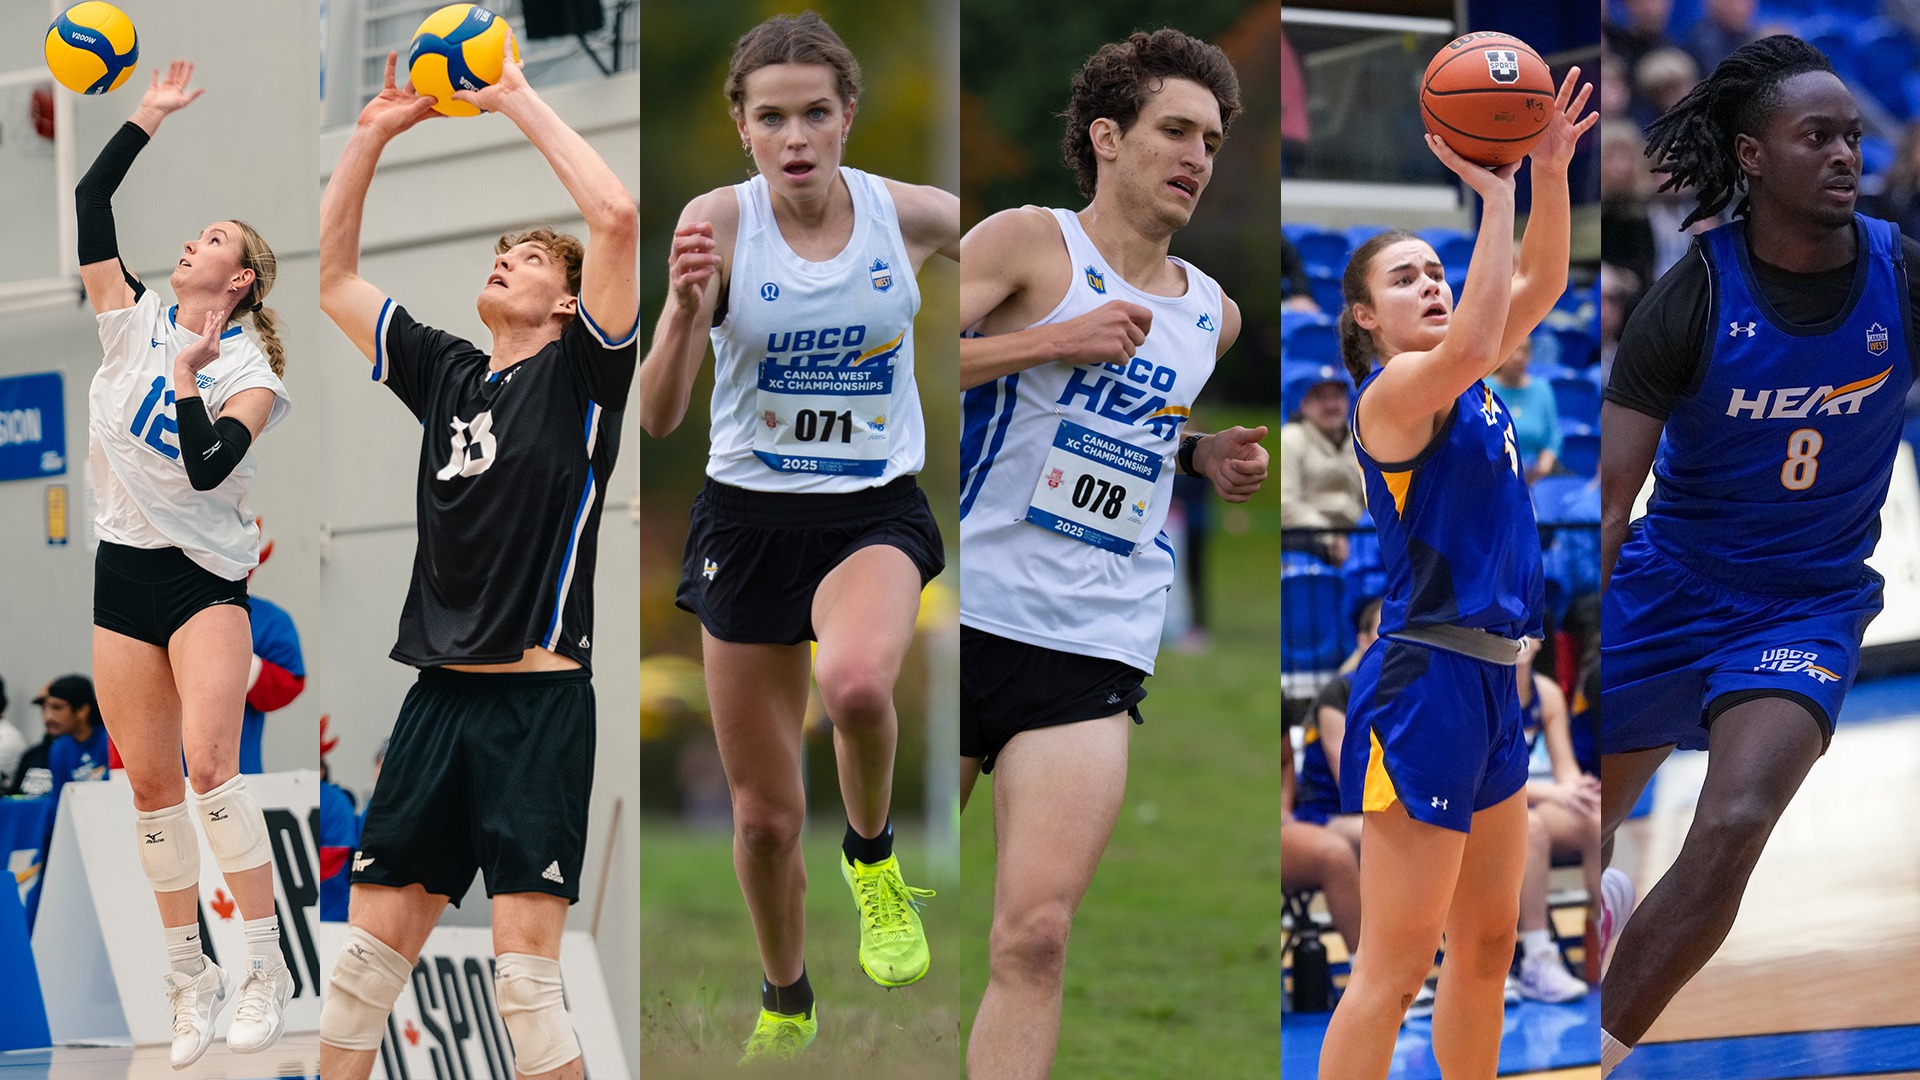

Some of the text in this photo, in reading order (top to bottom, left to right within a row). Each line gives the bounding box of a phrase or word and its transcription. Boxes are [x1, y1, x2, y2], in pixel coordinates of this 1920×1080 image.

[71, 31, 97, 45] V200W
[1490, 61, 1517, 70] SPORTS
[767, 325, 867, 353] UBCO
[1869, 341, 1887, 351] WEST
[768, 379, 884, 391] XC CHAMPIONSHIPS
[783, 370, 872, 381] CANADA WEST
[1056, 367, 1190, 441] HEAT
[1725, 370, 1890, 420] HEAT
[130, 375, 180, 460] 12
[795, 408, 853, 443] 071
[1065, 438, 1153, 476] XC CHAMPIONSHIPS
[1082, 433, 1149, 464] CANADA WEST
[1781, 428, 1823, 491] 8
[782, 458, 818, 471] 2025
[1072, 474, 1127, 520] 078
[1054, 520, 1085, 538] 2025
[1761, 648, 1819, 663] UBCO
